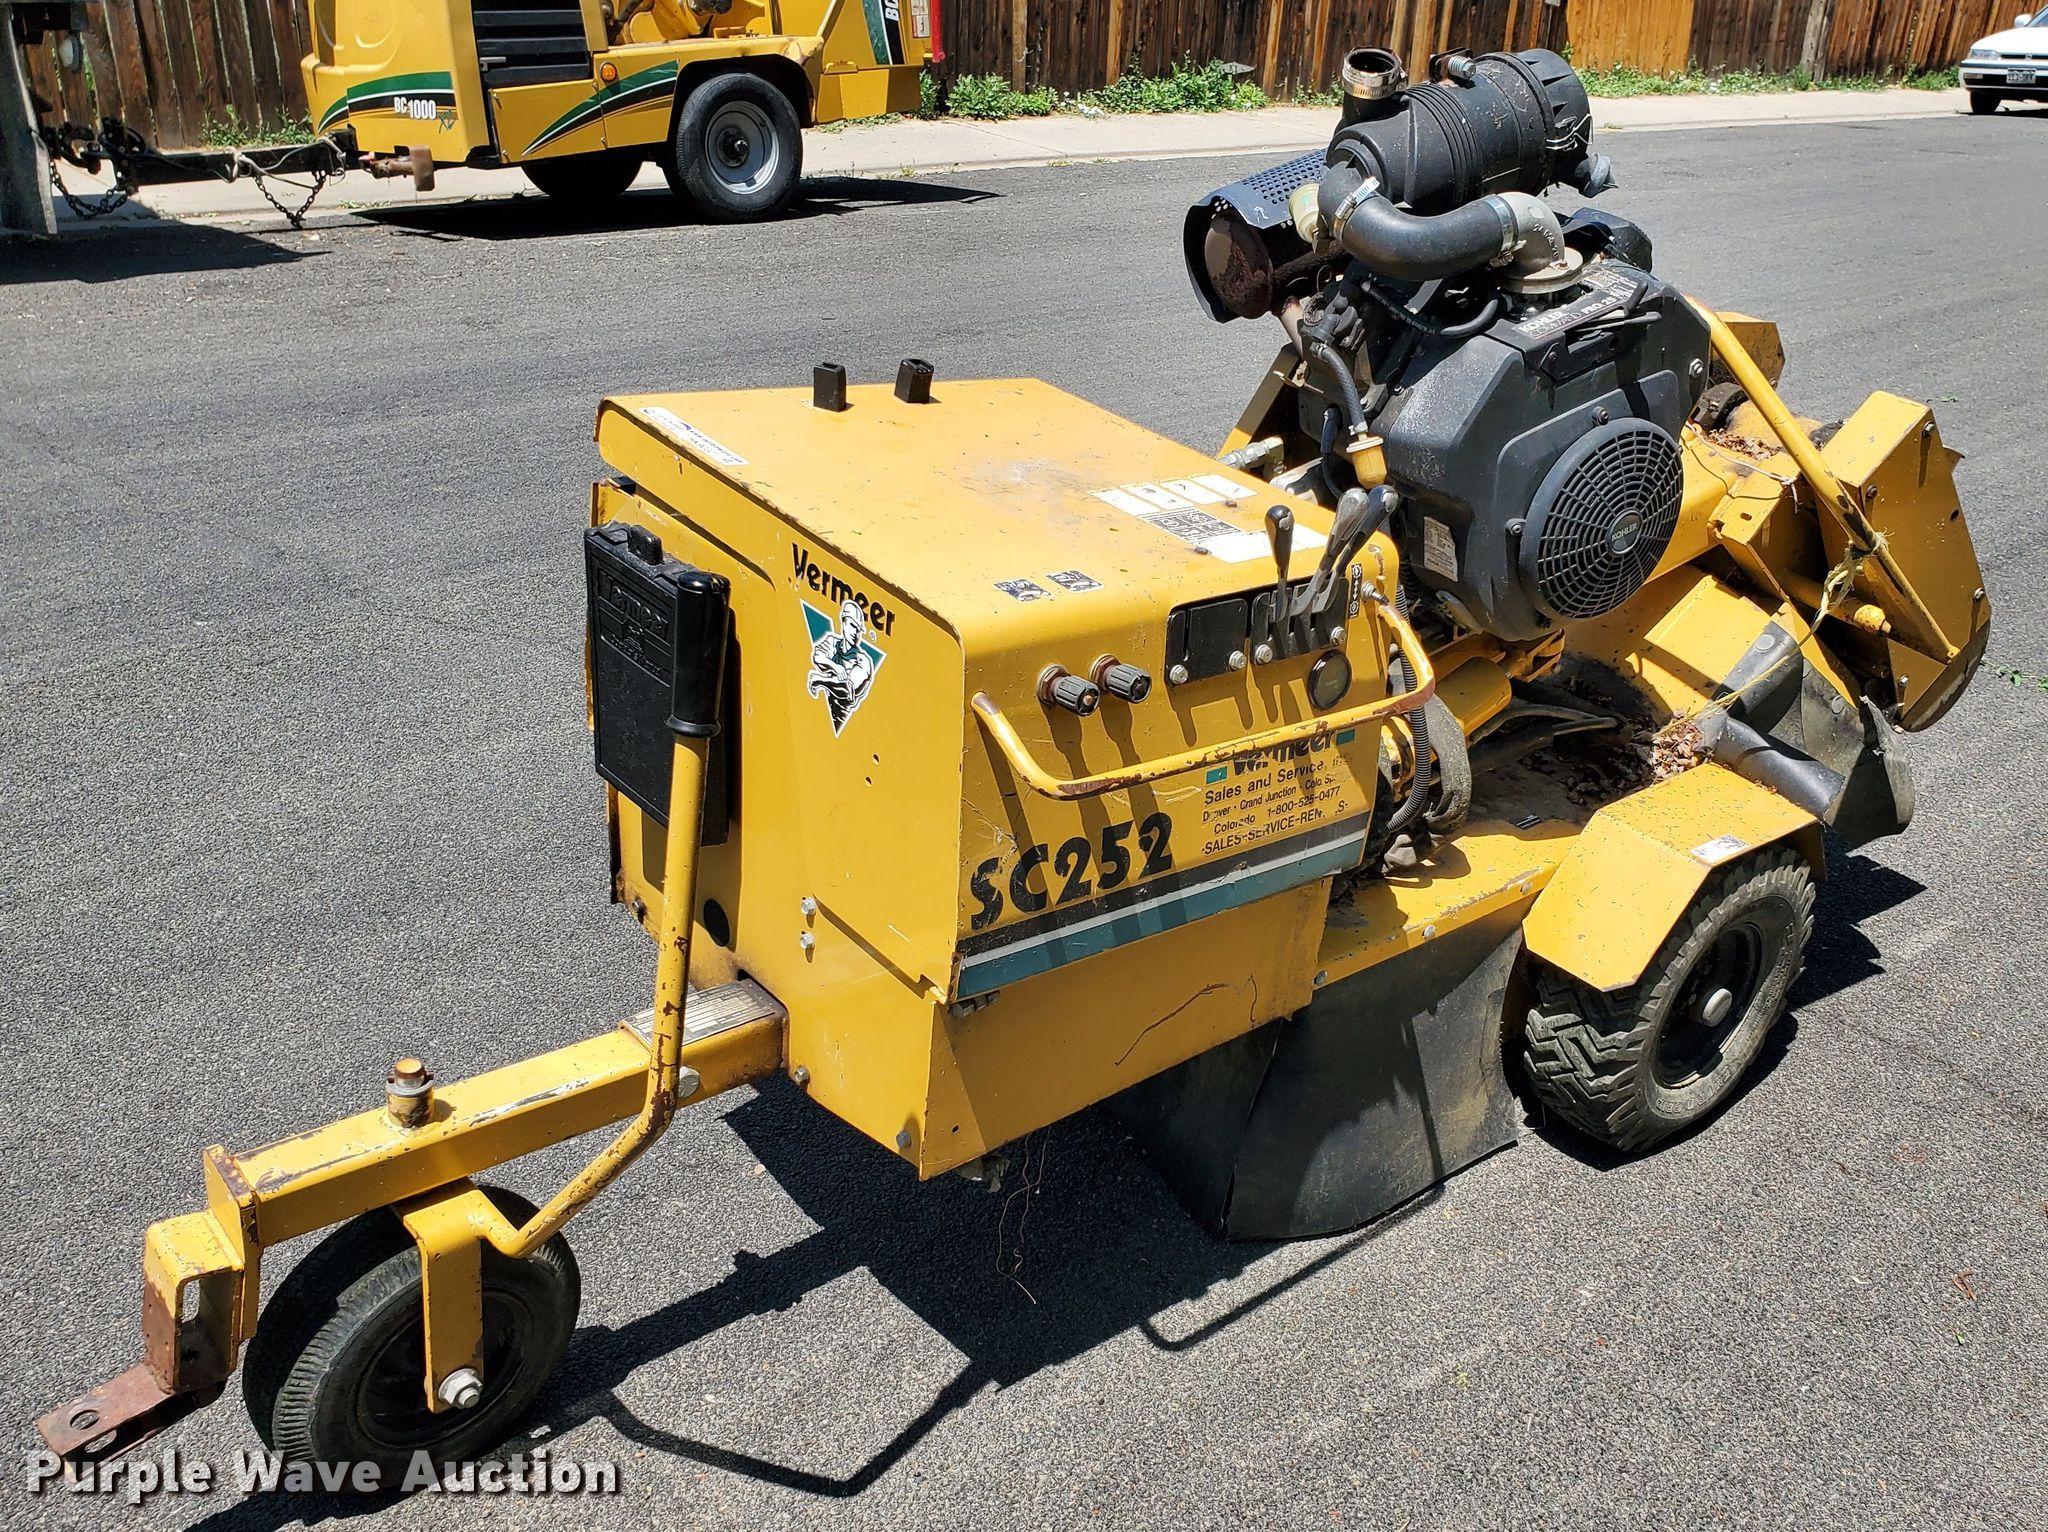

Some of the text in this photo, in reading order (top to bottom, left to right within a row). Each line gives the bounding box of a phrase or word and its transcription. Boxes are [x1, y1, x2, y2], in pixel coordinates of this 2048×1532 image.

[1518, 310, 1568, 333] KOHLER
[1612, 523, 1638, 542] KOHLER
[793, 542, 896, 637] Vermeer
[1205, 785, 1242, 805] Sales
[1247, 772, 1272, 793] and
[1240, 794, 1263, 810] Grand
[1265, 786, 1297, 803] Junction
[1267, 786, 1340, 818] 1-800-525-0477
[971, 812, 1173, 931] SC252
